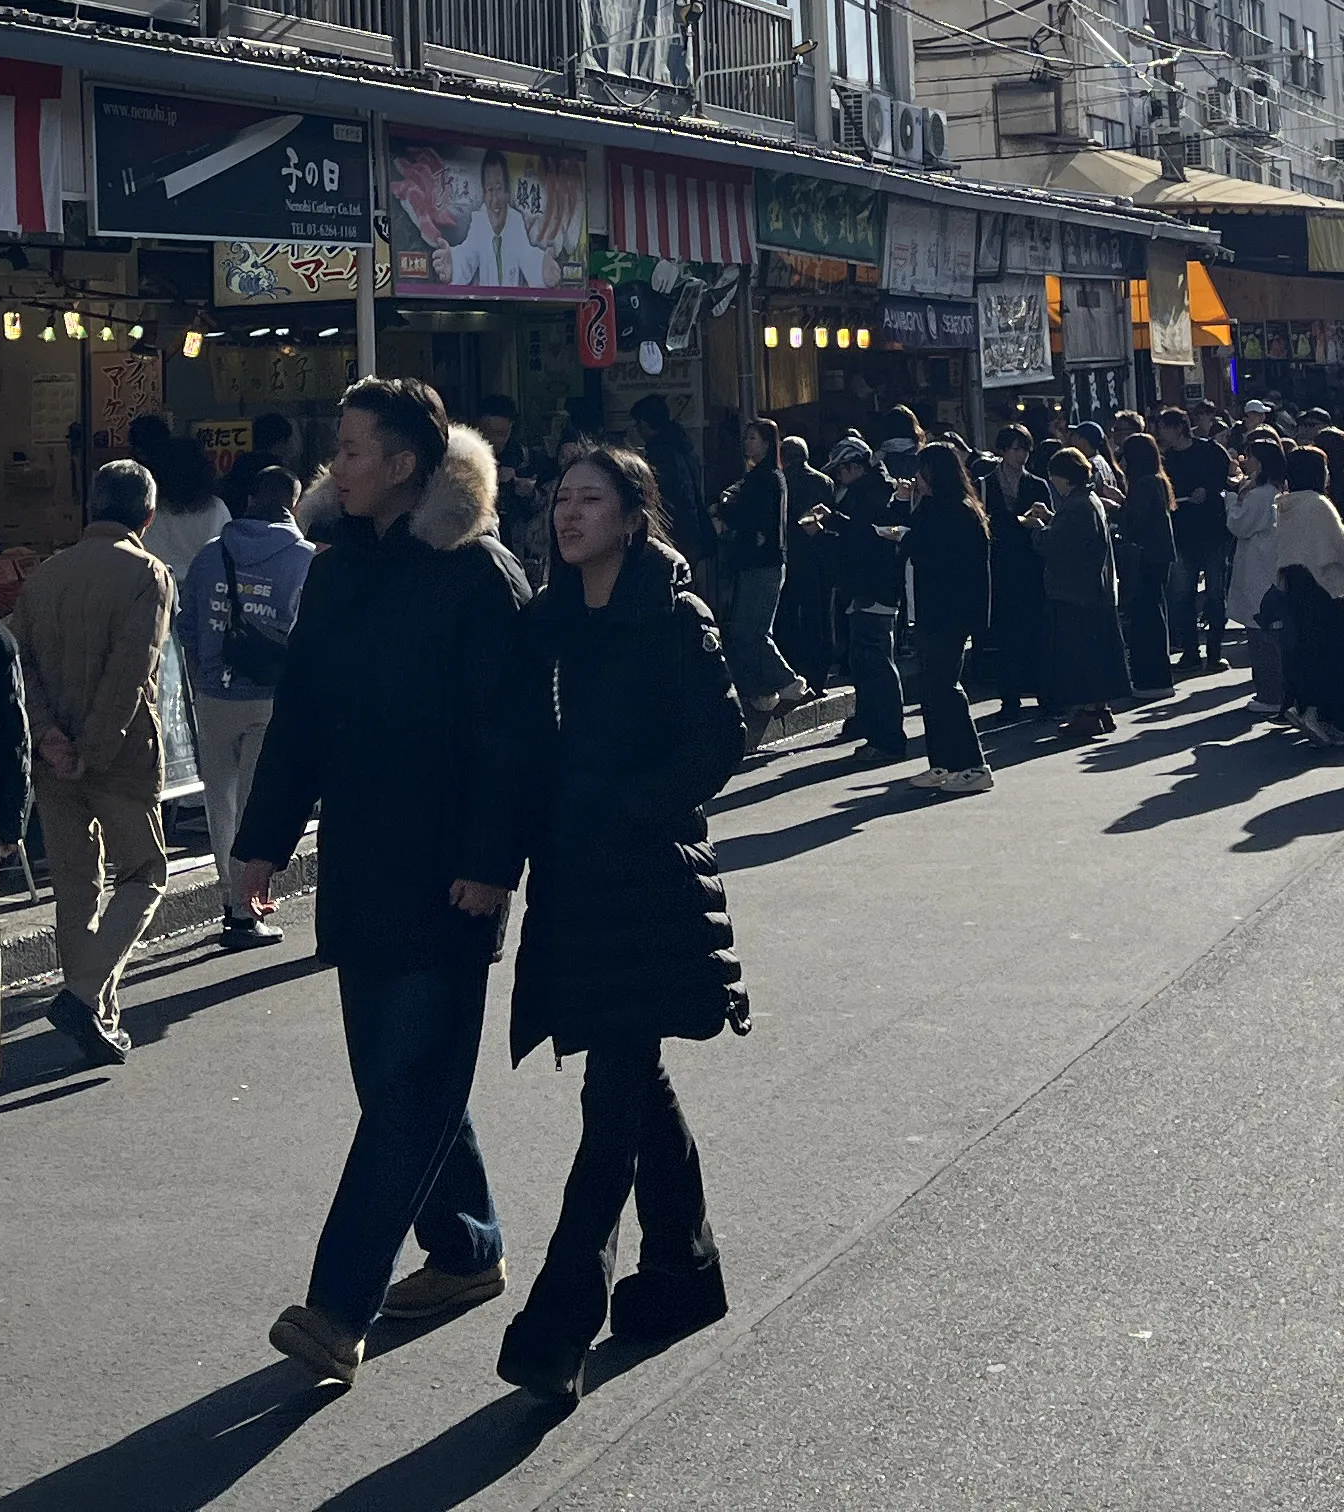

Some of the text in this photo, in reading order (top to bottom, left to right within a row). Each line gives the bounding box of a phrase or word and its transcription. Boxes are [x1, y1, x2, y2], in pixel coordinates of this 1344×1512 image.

[102, 103, 178, 127] www.nenohi.jp
[281, 146, 340, 194] 子の日
[291, 222, 306, 236] TEL
[101, 365, 126, 450] マーケット
[243, 602, 277, 620] OWN
